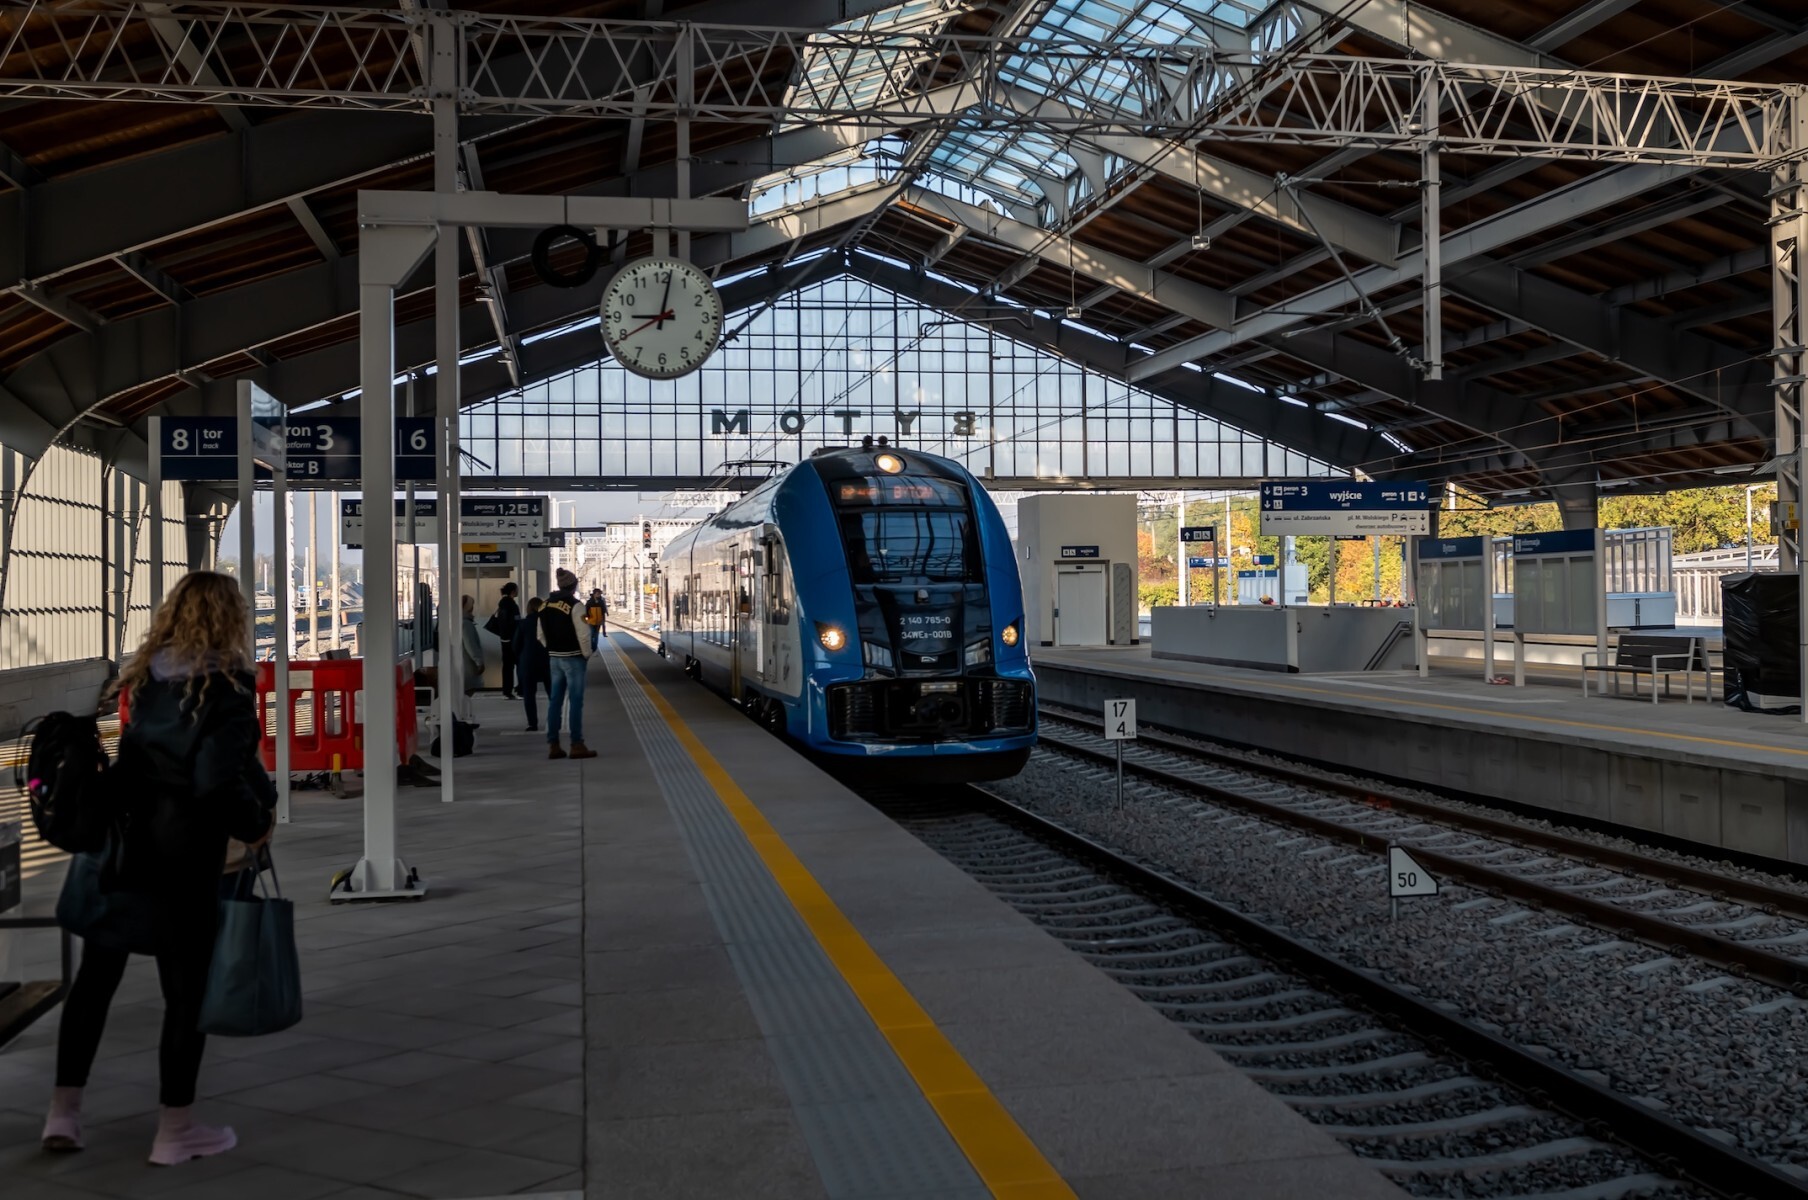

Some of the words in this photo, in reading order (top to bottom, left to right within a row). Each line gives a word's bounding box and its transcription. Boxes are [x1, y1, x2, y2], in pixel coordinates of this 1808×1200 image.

[633, 277, 646, 289] 11
[653, 271, 669, 284] 12
[681, 278, 687, 289] 1
[619, 294, 635, 306] 10
[694, 295, 703, 307] 2
[613, 310, 622, 323] 9
[701, 312, 710, 324] 3
[619, 328, 628, 341] 8
[694, 330, 703, 341] 4
[635, 346, 643, 358] 7
[680, 347, 689, 359] 5
[658, 353, 666, 365] 6
[172, 428, 189, 451] 8
[203, 429, 223, 439] tor
[286, 426, 312, 437] ron
[315, 424, 334, 451] 3
[410, 428, 427, 451] 6
[308, 460, 319, 475] B
[1301, 486, 1308, 496] 3
[1329, 490, 1362, 502] wyjście
[1399, 492, 1405, 501] 1
[498, 504, 516, 516] 1,2
[899, 617, 906, 625] 2
[908, 616, 922, 625] 140
[925, 616, 951, 625] 765-0
[1112, 701, 1128, 718] 17
[1116, 721, 1126, 737] 4
[1397, 871, 1417, 888] 50
